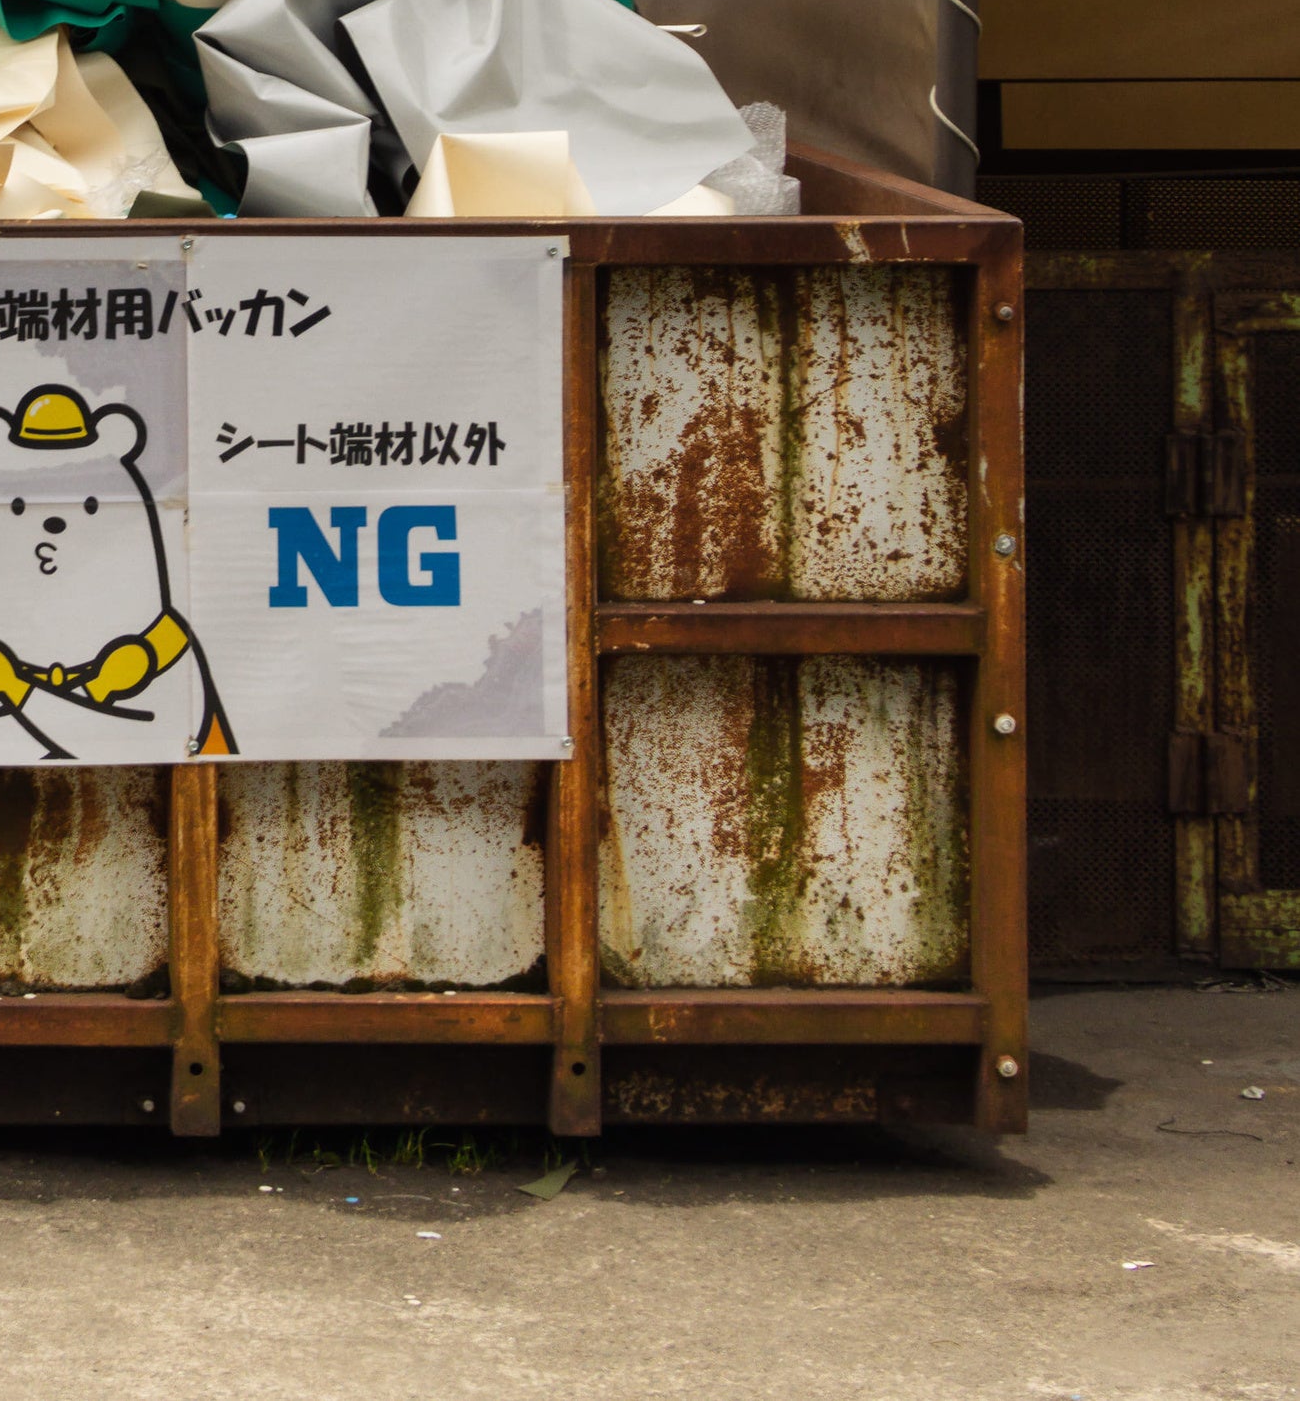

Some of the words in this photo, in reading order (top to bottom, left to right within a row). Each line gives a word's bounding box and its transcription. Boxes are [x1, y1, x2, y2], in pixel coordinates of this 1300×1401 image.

[216, 421, 507, 467] シート端材以外
[268, 505, 462, 609] NG
